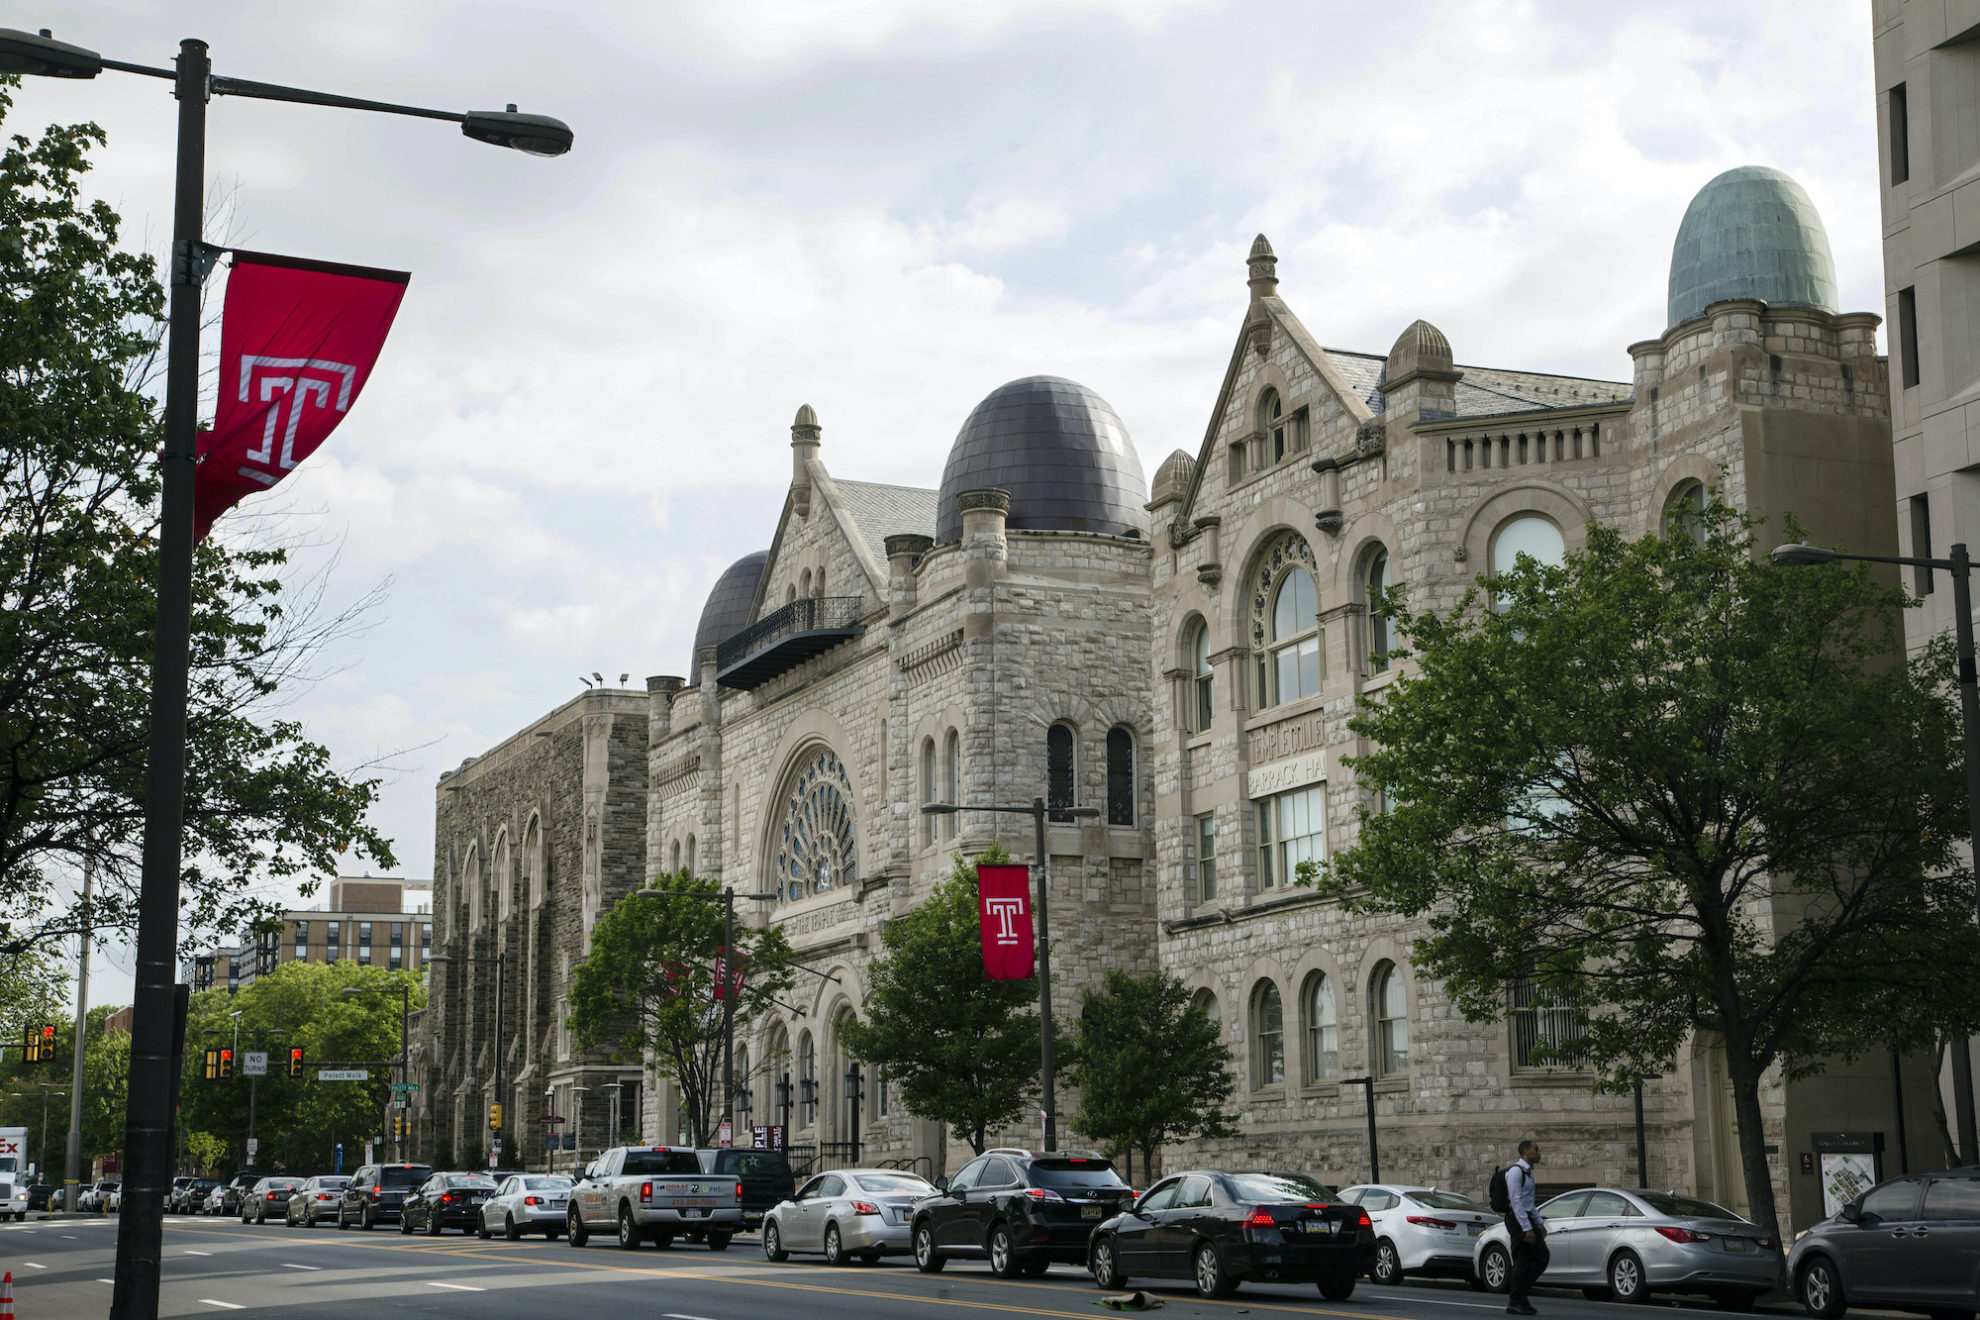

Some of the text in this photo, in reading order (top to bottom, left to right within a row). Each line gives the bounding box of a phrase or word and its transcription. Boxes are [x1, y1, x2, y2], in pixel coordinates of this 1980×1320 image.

[1249, 728, 1290, 766] TEMPLE
[1249, 763, 1298, 795] BARRACK
[986, 897, 1024, 945] T
[244, 1065, 266, 1073] TURNS
[249, 1055, 262, 1064] NO
[346, 1072, 362, 1080] Walk
